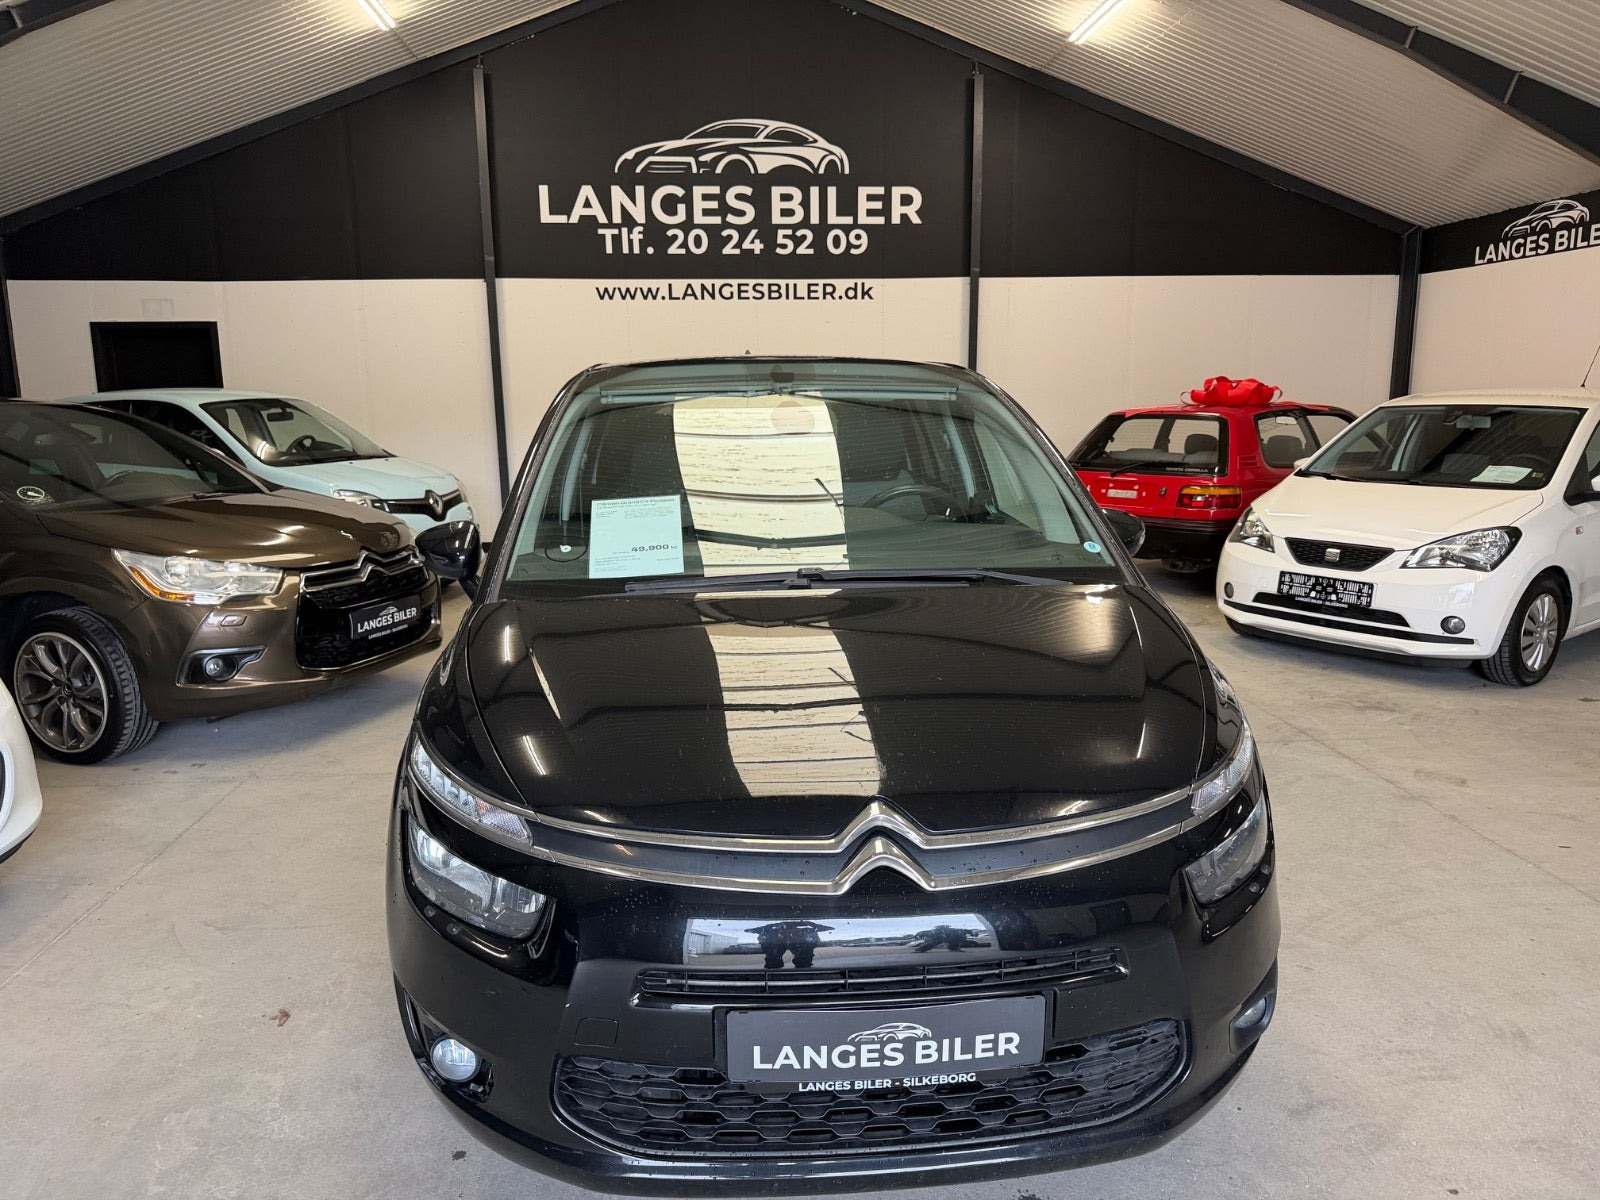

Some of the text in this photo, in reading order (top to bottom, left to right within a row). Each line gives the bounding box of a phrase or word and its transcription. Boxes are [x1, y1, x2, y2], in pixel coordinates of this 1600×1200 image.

[538, 184, 923, 225] LANGES BILER
[597, 226, 869, 255] Tlf. 20 24 52 09
[1474, 233, 1550, 265] LANGES
[595, 282, 874, 301] www.LANGESBILER.dk
[631, 544, 669, 552] 49.900
[357, 607, 417, 633] LANGES BILER
[753, 1031, 1020, 1070] LANGES BILER
[799, 1080, 851, 1092] LANGES
[854, 1078, 892, 1090] BILER
[903, 1073, 976, 1087] SILKEBORG
